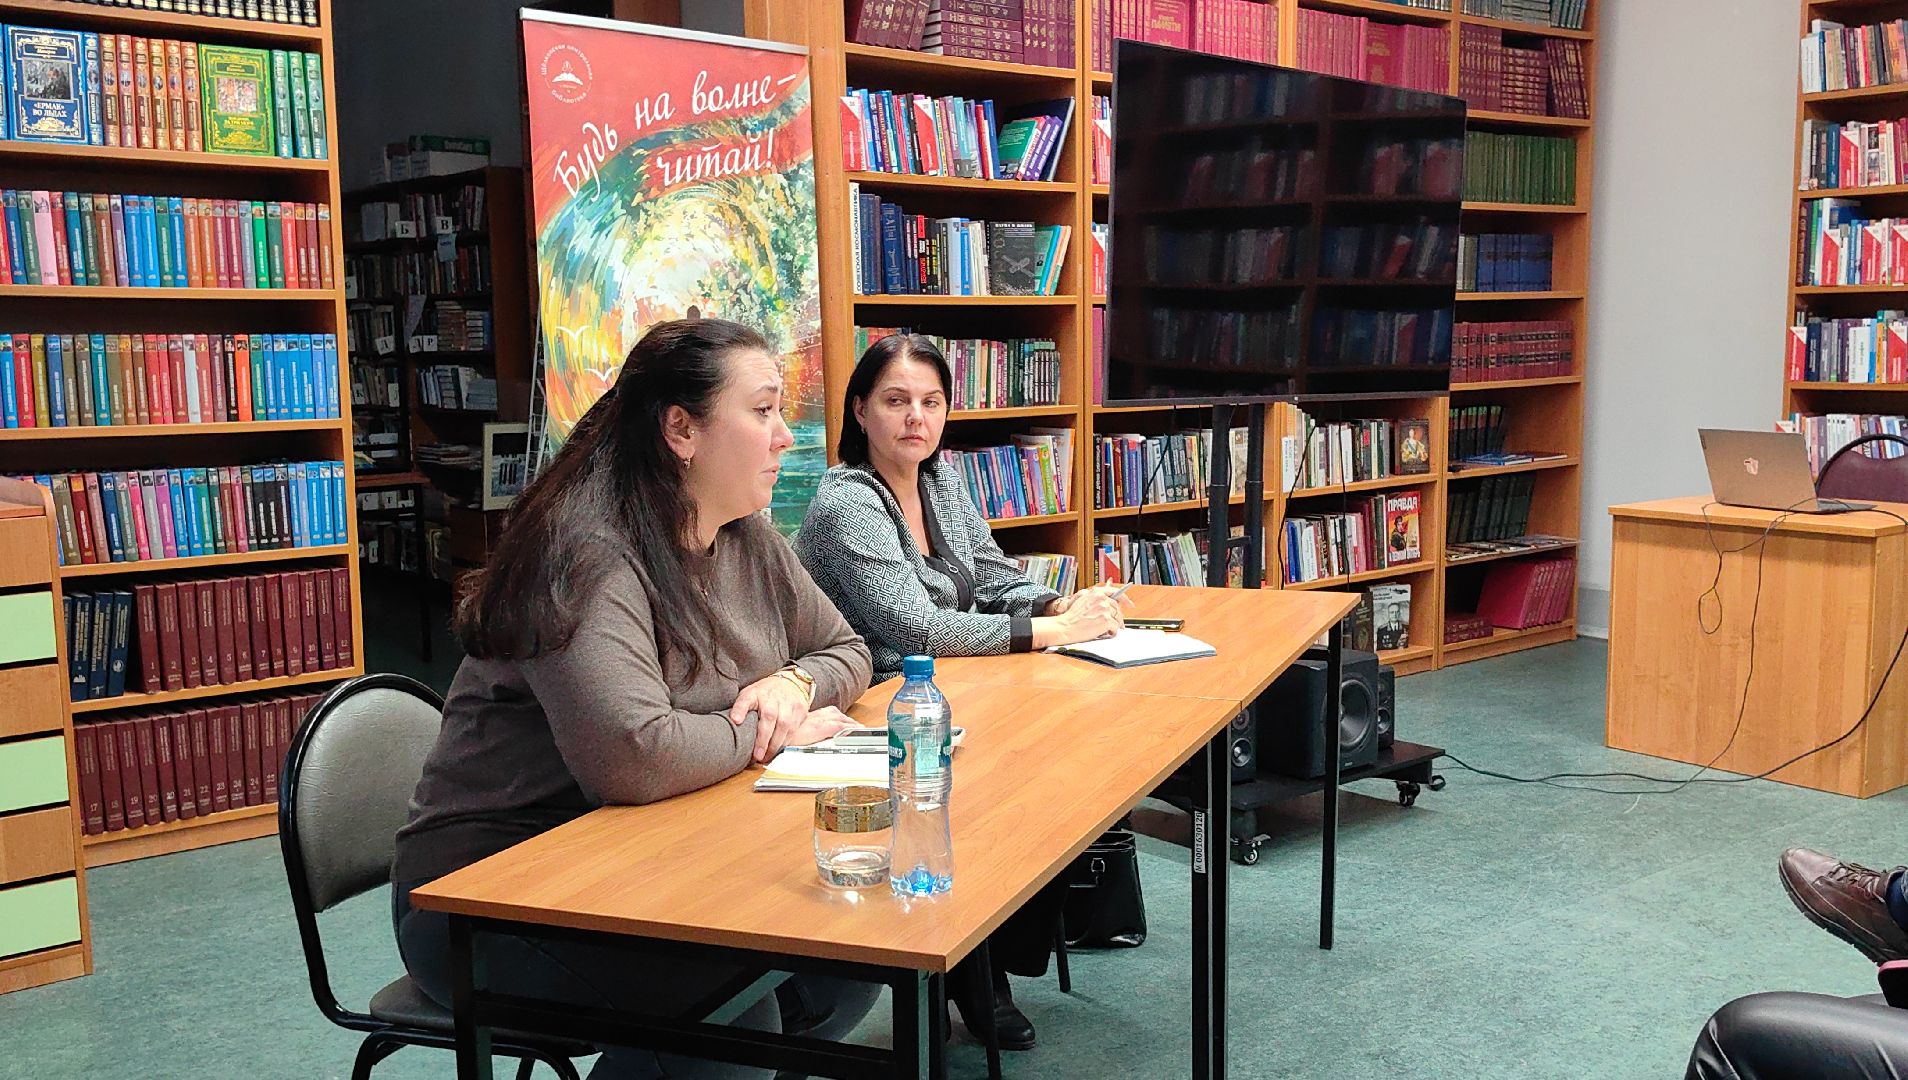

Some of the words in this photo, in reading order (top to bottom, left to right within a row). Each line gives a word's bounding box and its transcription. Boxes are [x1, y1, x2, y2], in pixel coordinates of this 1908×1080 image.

[553, 122, 618, 200] Будь
[635, 92, 676, 130] на
[656, 128, 774, 187] читай!
[441, 220, 449, 230] В
[1388, 496, 1418, 512] ПРАВДА
[207, 655, 213, 663] 4
